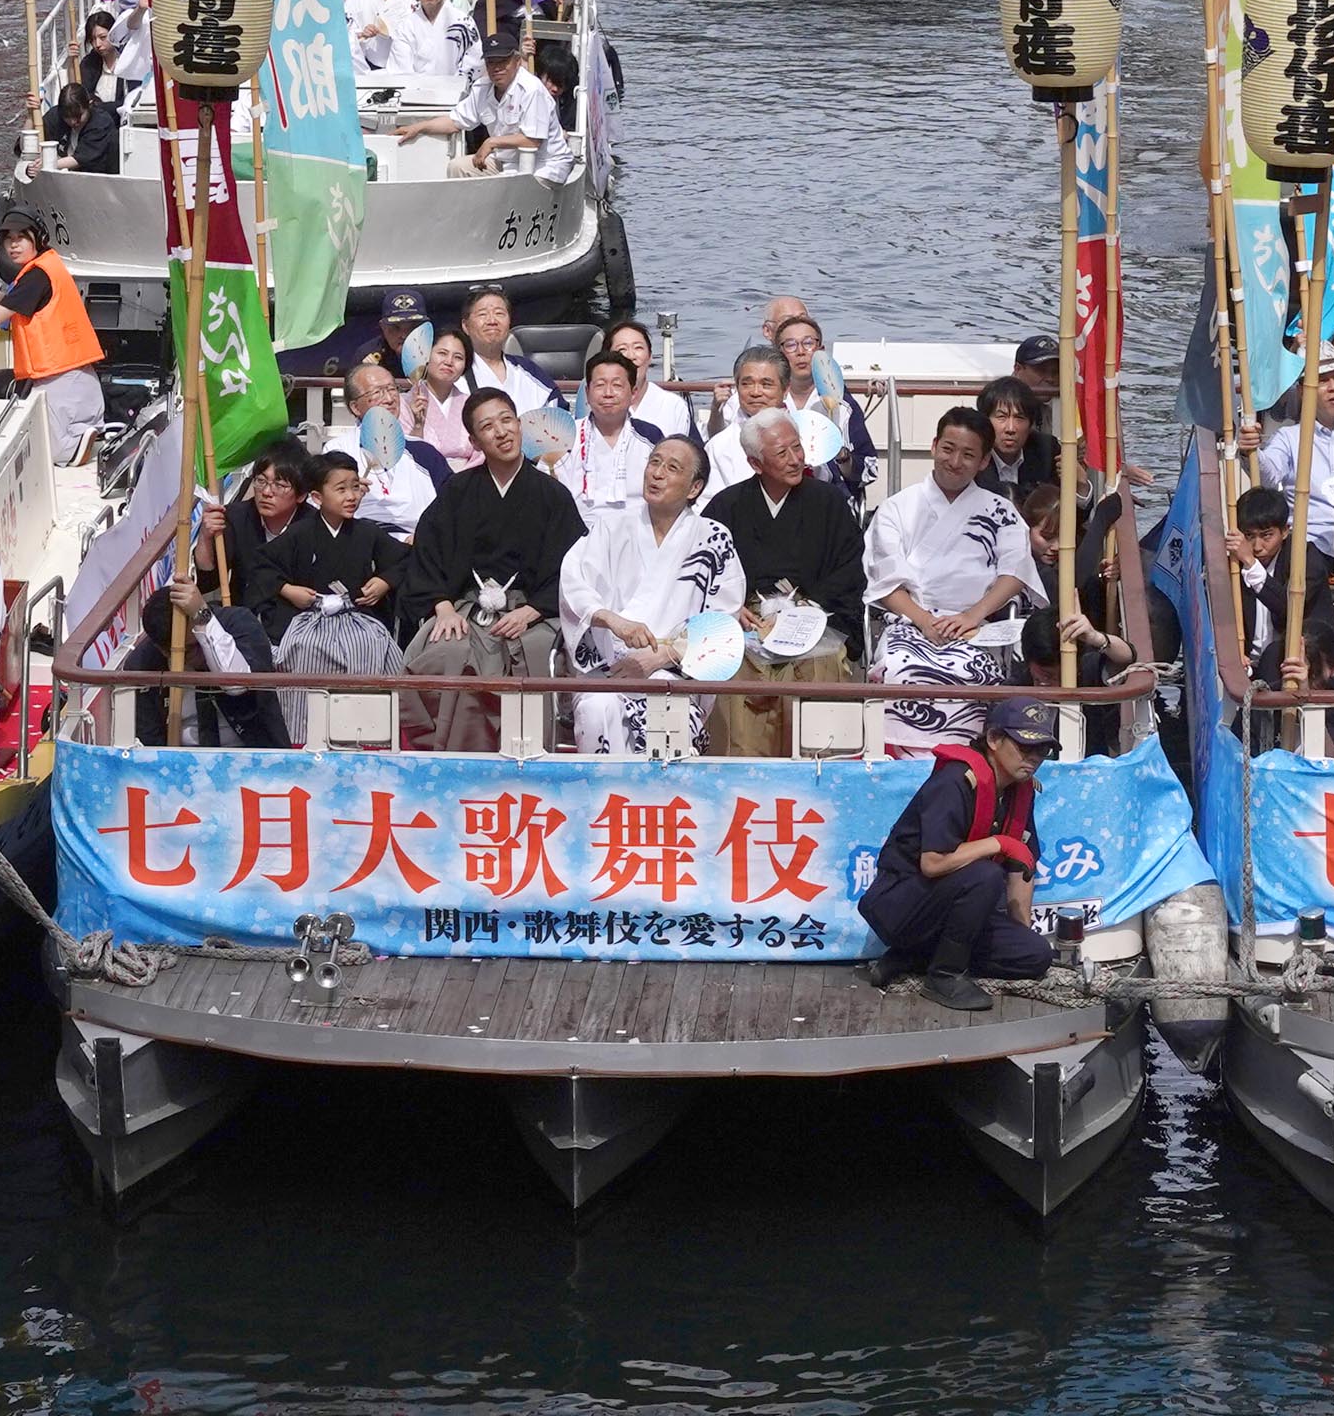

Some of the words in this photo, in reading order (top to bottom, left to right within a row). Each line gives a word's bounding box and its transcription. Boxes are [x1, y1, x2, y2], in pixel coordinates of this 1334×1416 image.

[98, 785, 833, 903] 七月大歌舞伎
[424, 907, 827, 950] 関西・歌舞伎を愛する会
